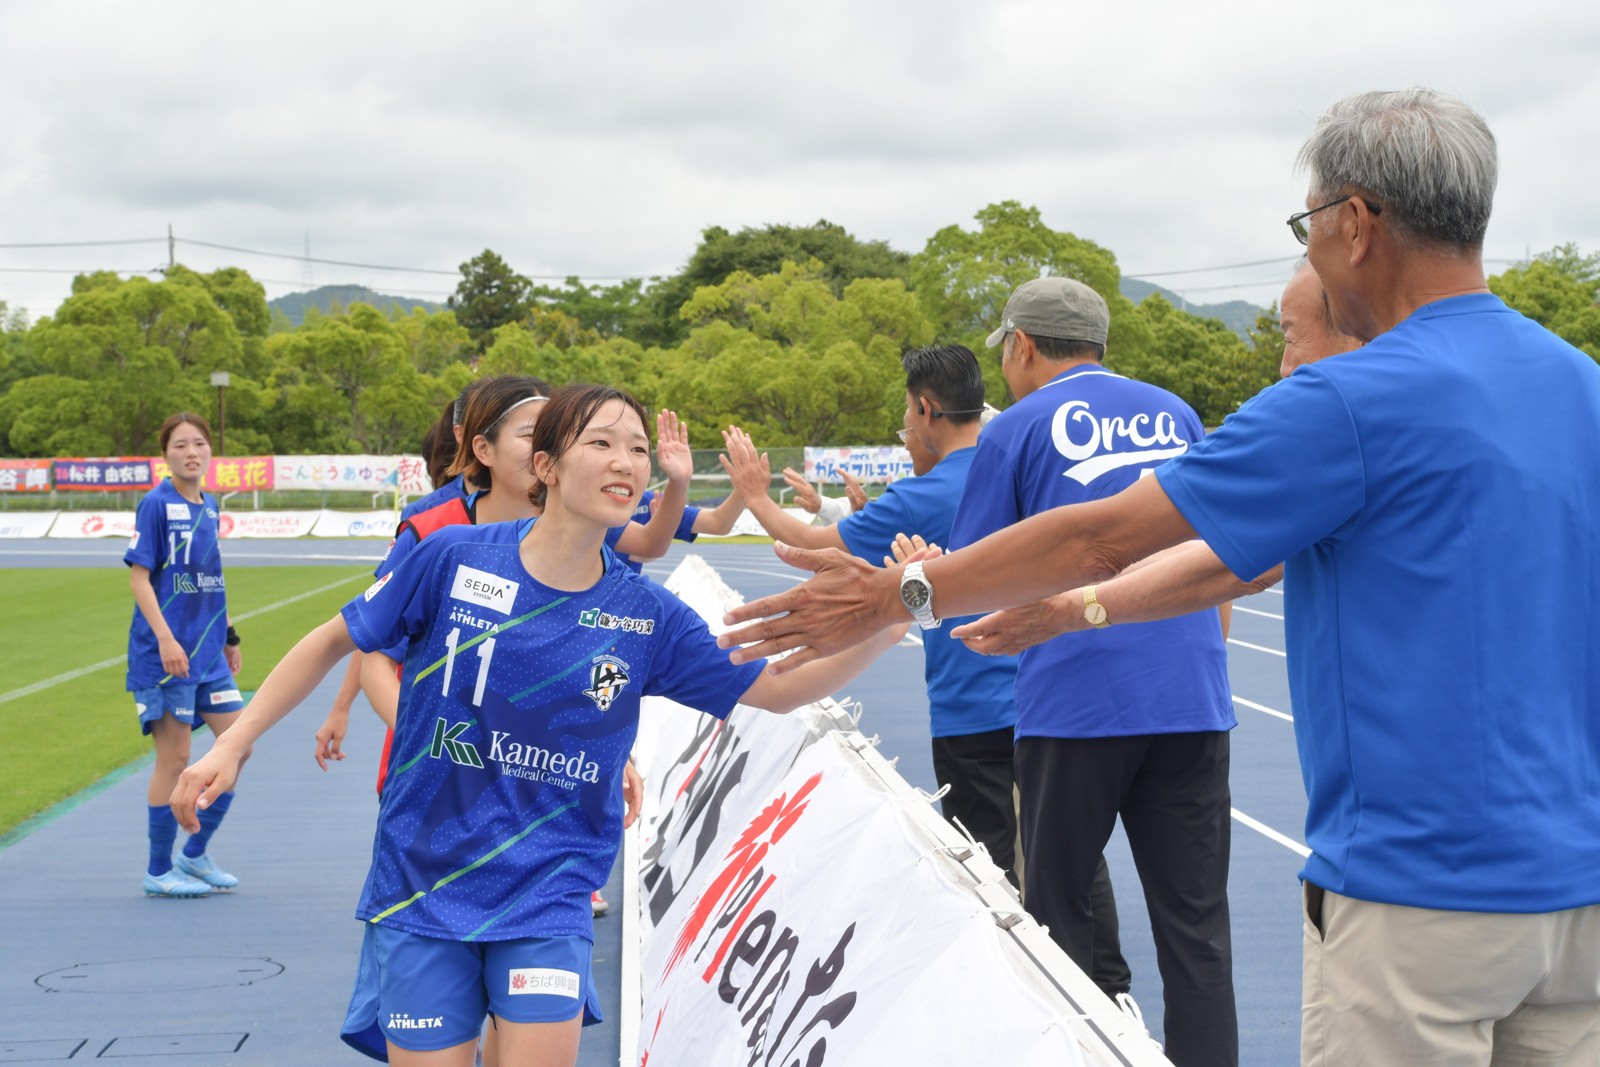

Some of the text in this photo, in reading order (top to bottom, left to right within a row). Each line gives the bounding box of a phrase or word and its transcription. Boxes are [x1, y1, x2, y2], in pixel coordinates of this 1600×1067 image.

[1051, 400, 1188, 461] Orca
[281, 465, 388, 481] こんどうあゆこ
[168, 531, 193, 565] 17
[197, 572, 225, 588] Kamed
[464, 578, 504, 599] SEDIA
[449, 611, 499, 634] ATHLETA
[441, 627, 497, 708] 11
[487, 730, 600, 784] Kameda
[501, 763, 577, 791] Medical Center
[529, 974, 577, 993] ちば興銀
[387, 1017, 443, 1029] ATHLETA
